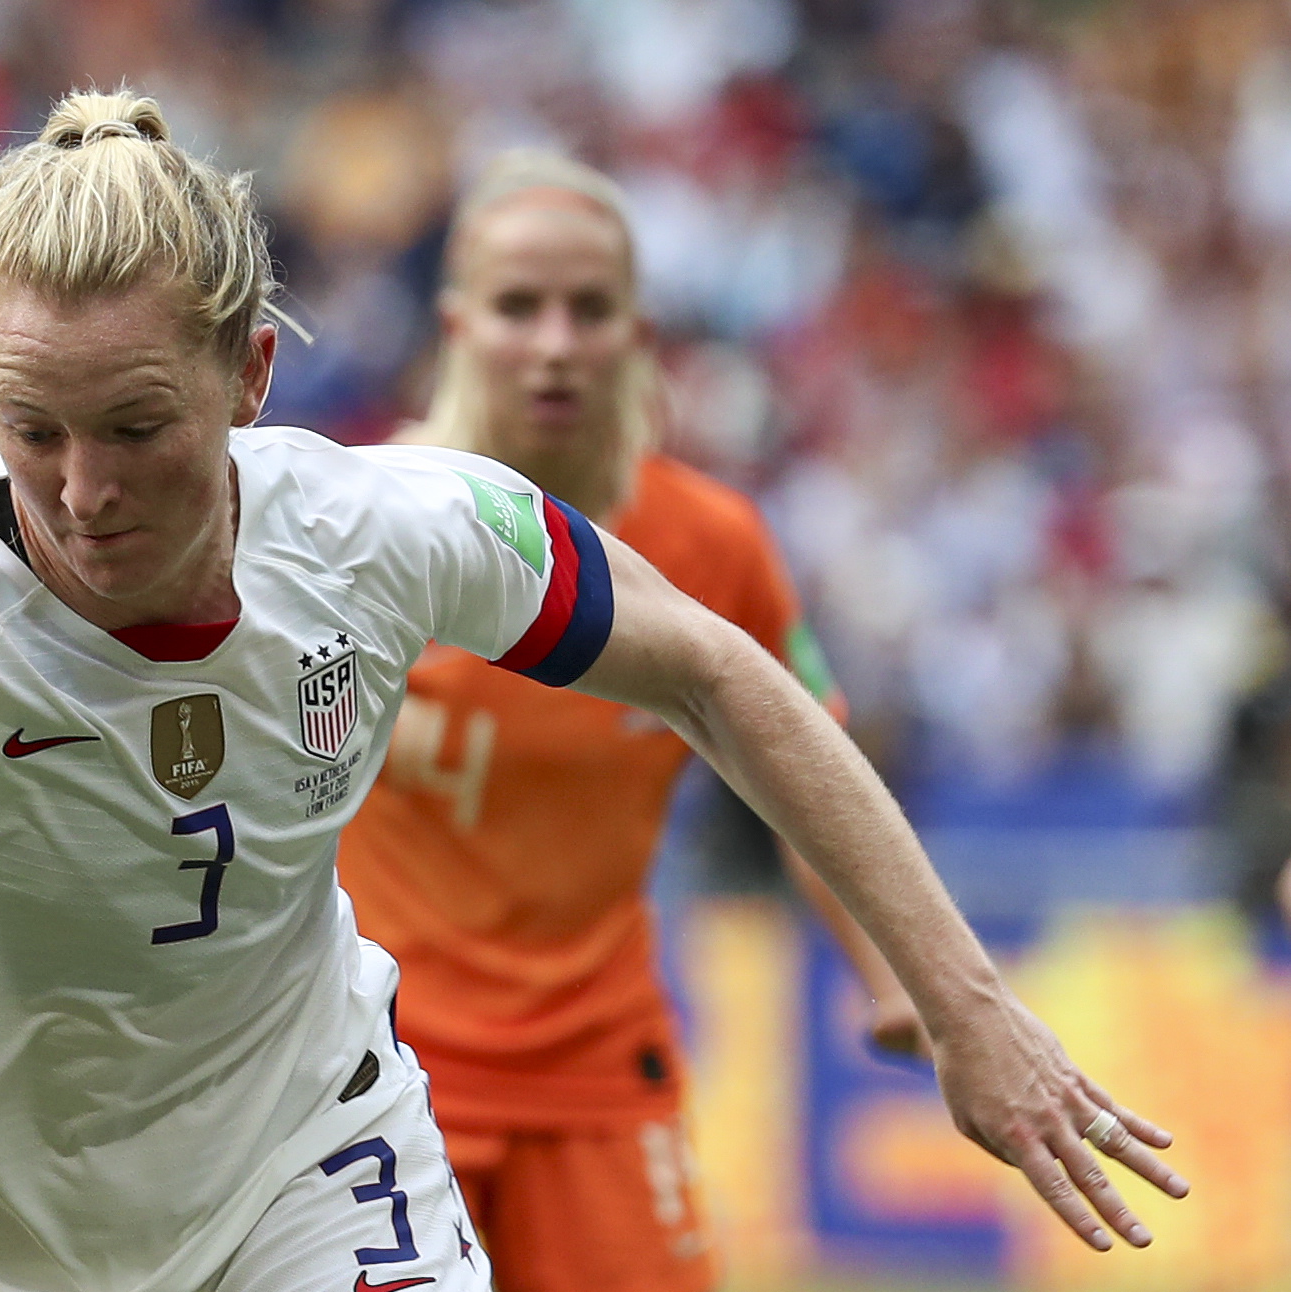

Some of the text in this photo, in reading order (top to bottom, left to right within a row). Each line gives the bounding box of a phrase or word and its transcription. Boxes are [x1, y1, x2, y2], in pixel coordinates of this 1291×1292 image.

[304, 660, 351, 707] USA
[172, 759, 206, 777] FIFA
[294, 776, 311, 793] USA
[150, 801, 236, 946] 3
[318, 1135, 420, 1267] 3
